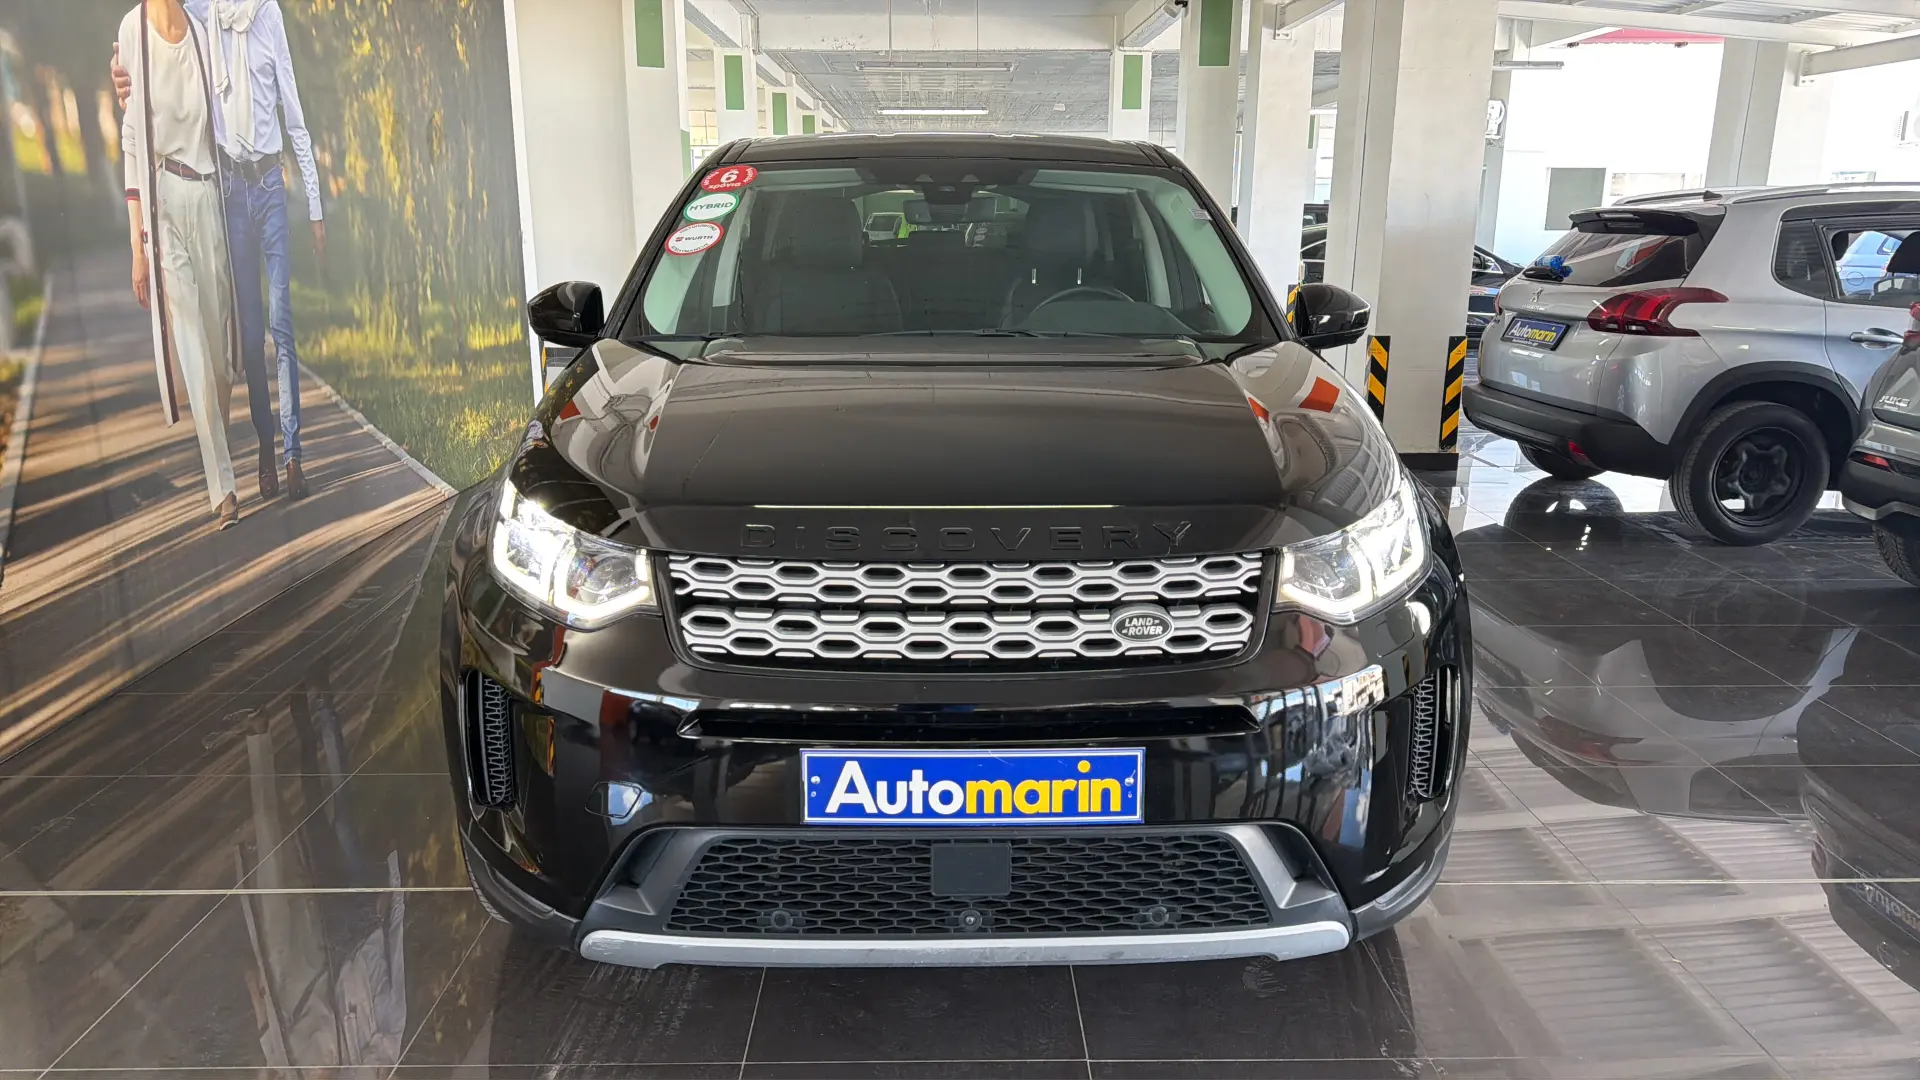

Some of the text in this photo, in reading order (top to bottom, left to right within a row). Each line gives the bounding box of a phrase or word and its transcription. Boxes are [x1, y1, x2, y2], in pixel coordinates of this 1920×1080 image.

[720, 170, 739, 183] 6
[689, 202, 733, 211] HYBRID
[1508, 321, 1557, 342] Automarin
[740, 521, 1192, 552] DISCOVERY
[1125, 617, 1153, 627] LAND
[1128, 625, 1163, 636] ROVER
[824, 759, 1122, 815] Automarin
